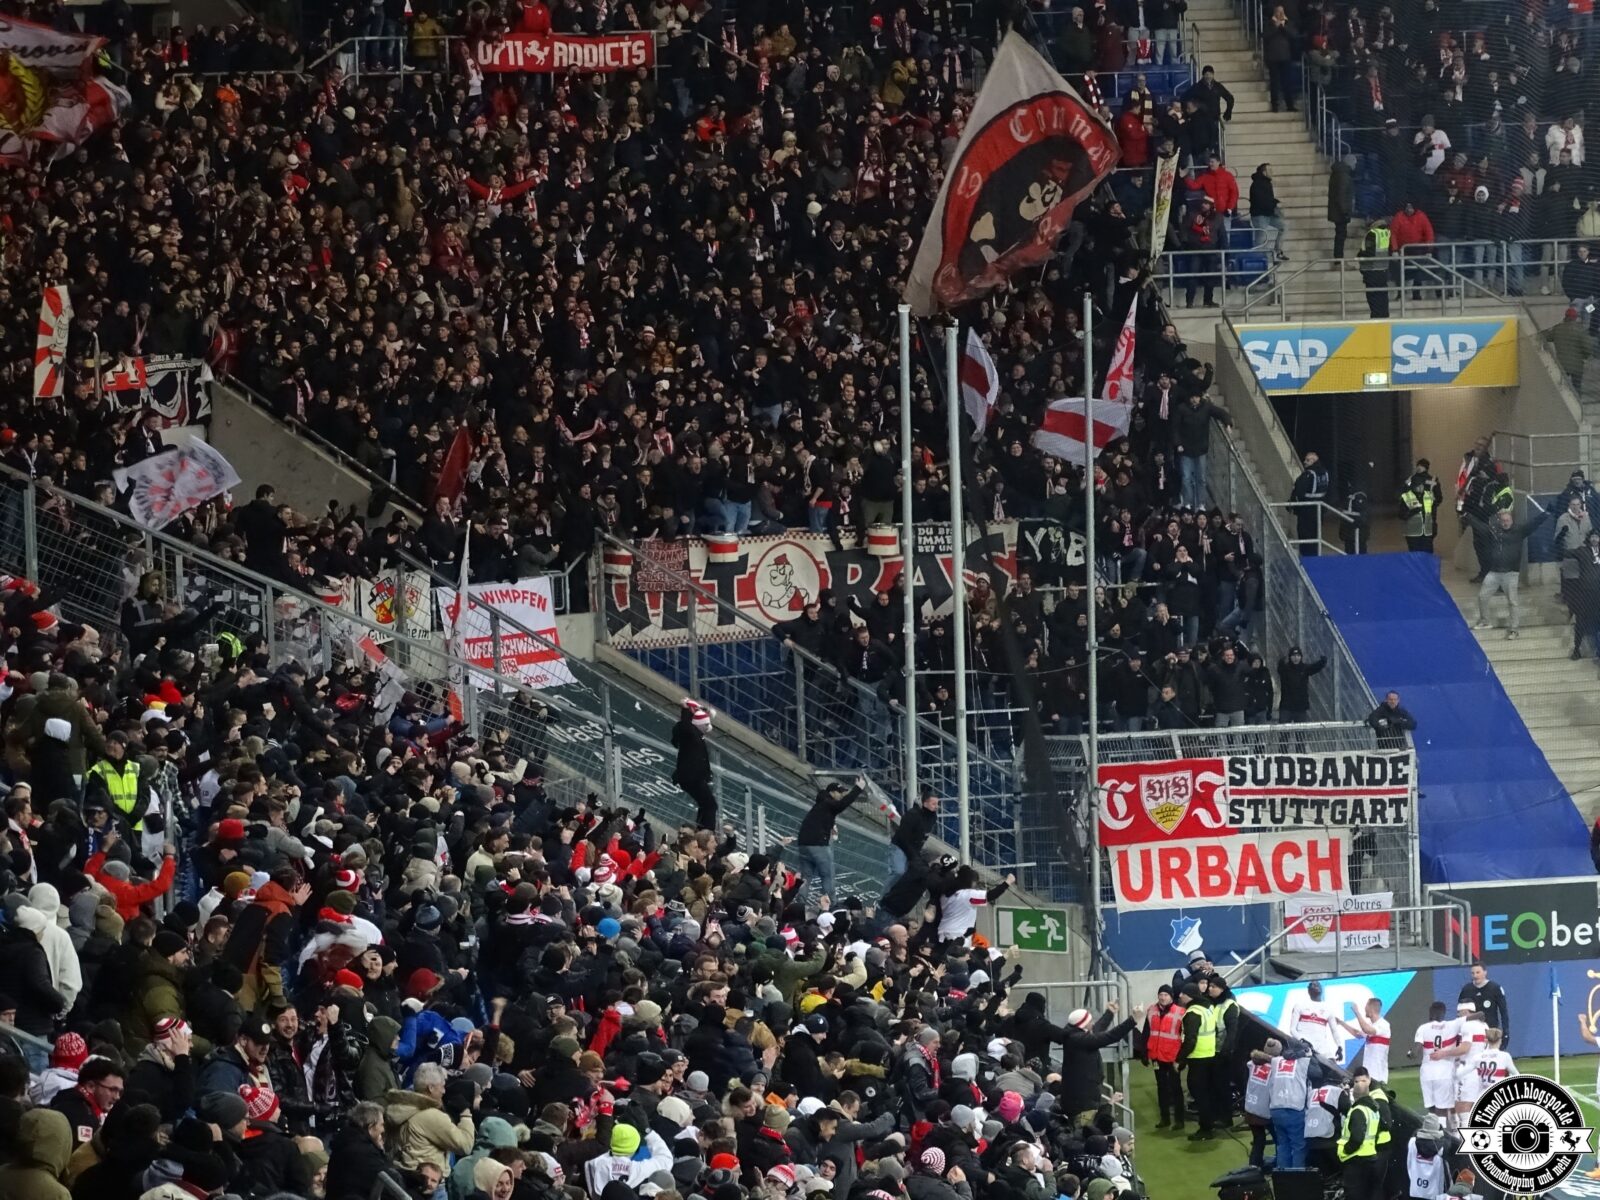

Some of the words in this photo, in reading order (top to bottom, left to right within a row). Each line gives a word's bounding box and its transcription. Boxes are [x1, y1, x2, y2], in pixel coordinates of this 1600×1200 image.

[552, 38, 647, 68] ADDICTS
[1243, 338, 1328, 380] SAP
[1392, 333, 1478, 375] SAP
[478, 588, 549, 613] WIMPFEN
[1228, 753, 1410, 788] SÜDBANDE
[1228, 797, 1409, 826] STUTTGART
[1116, 838, 1343, 904] URBACH
[1343, 898, 1382, 911] Oberes
[1479, 1061, 1497, 1084] 22
[1416, 1177, 1429, 1189] 09
